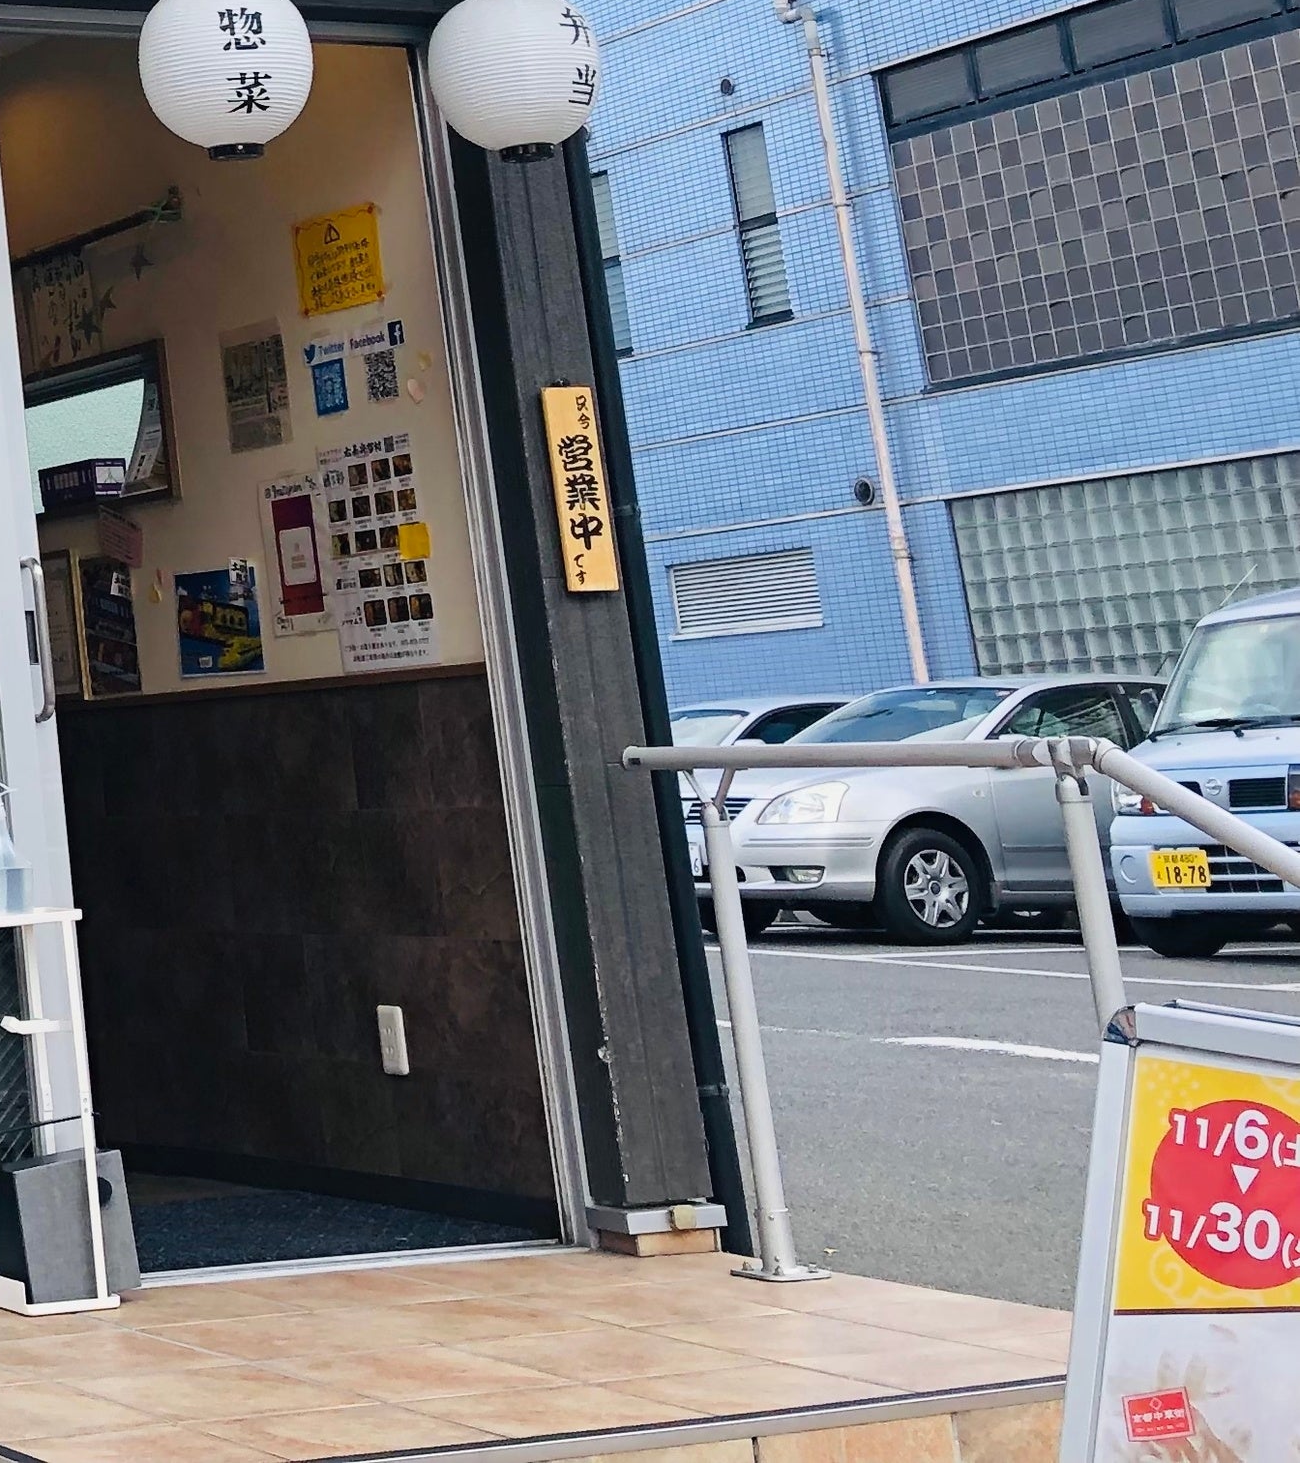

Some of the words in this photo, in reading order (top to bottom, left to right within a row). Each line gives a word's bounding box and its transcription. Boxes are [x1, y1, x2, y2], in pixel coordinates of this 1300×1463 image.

[217, 7, 273, 115] 惣菜
[559, 7, 598, 107] 弁当
[318, 341, 345, 356] Twitter
[349, 331, 386, 350] Facebook
[558, 434, 604, 551] 営業中
[1165, 865, 1207, 884] 18-78
